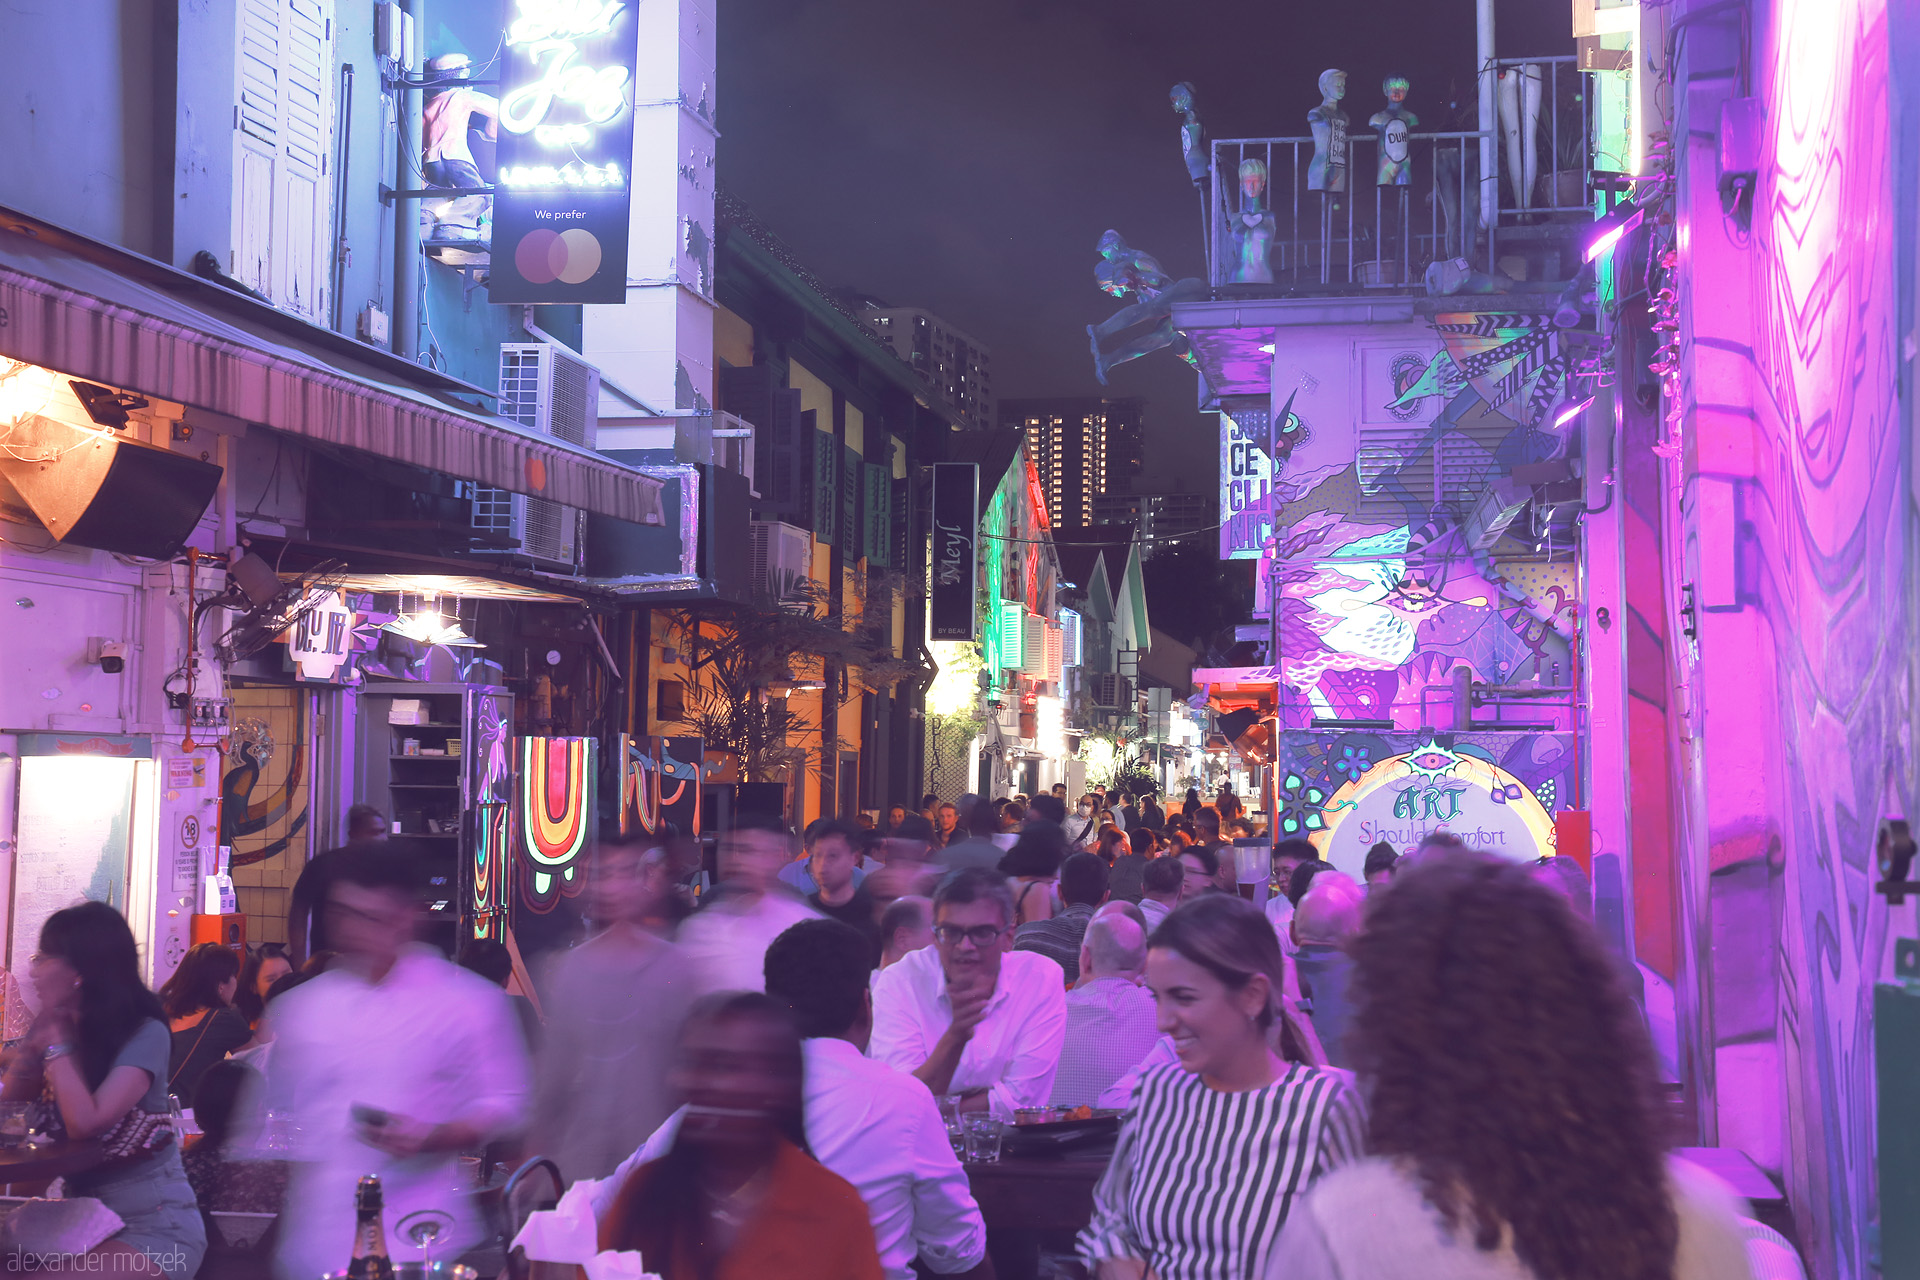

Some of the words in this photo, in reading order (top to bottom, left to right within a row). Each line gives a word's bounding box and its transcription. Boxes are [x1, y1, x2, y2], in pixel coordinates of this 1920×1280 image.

[534, 209, 552, 219] We
[554, 209, 587, 221] prefer
[1230, 442, 1259, 477] CE
[1229, 478, 1268, 512] CLI
[1230, 512, 1272, 549] NIC
[1393, 784, 1467, 822] ART
